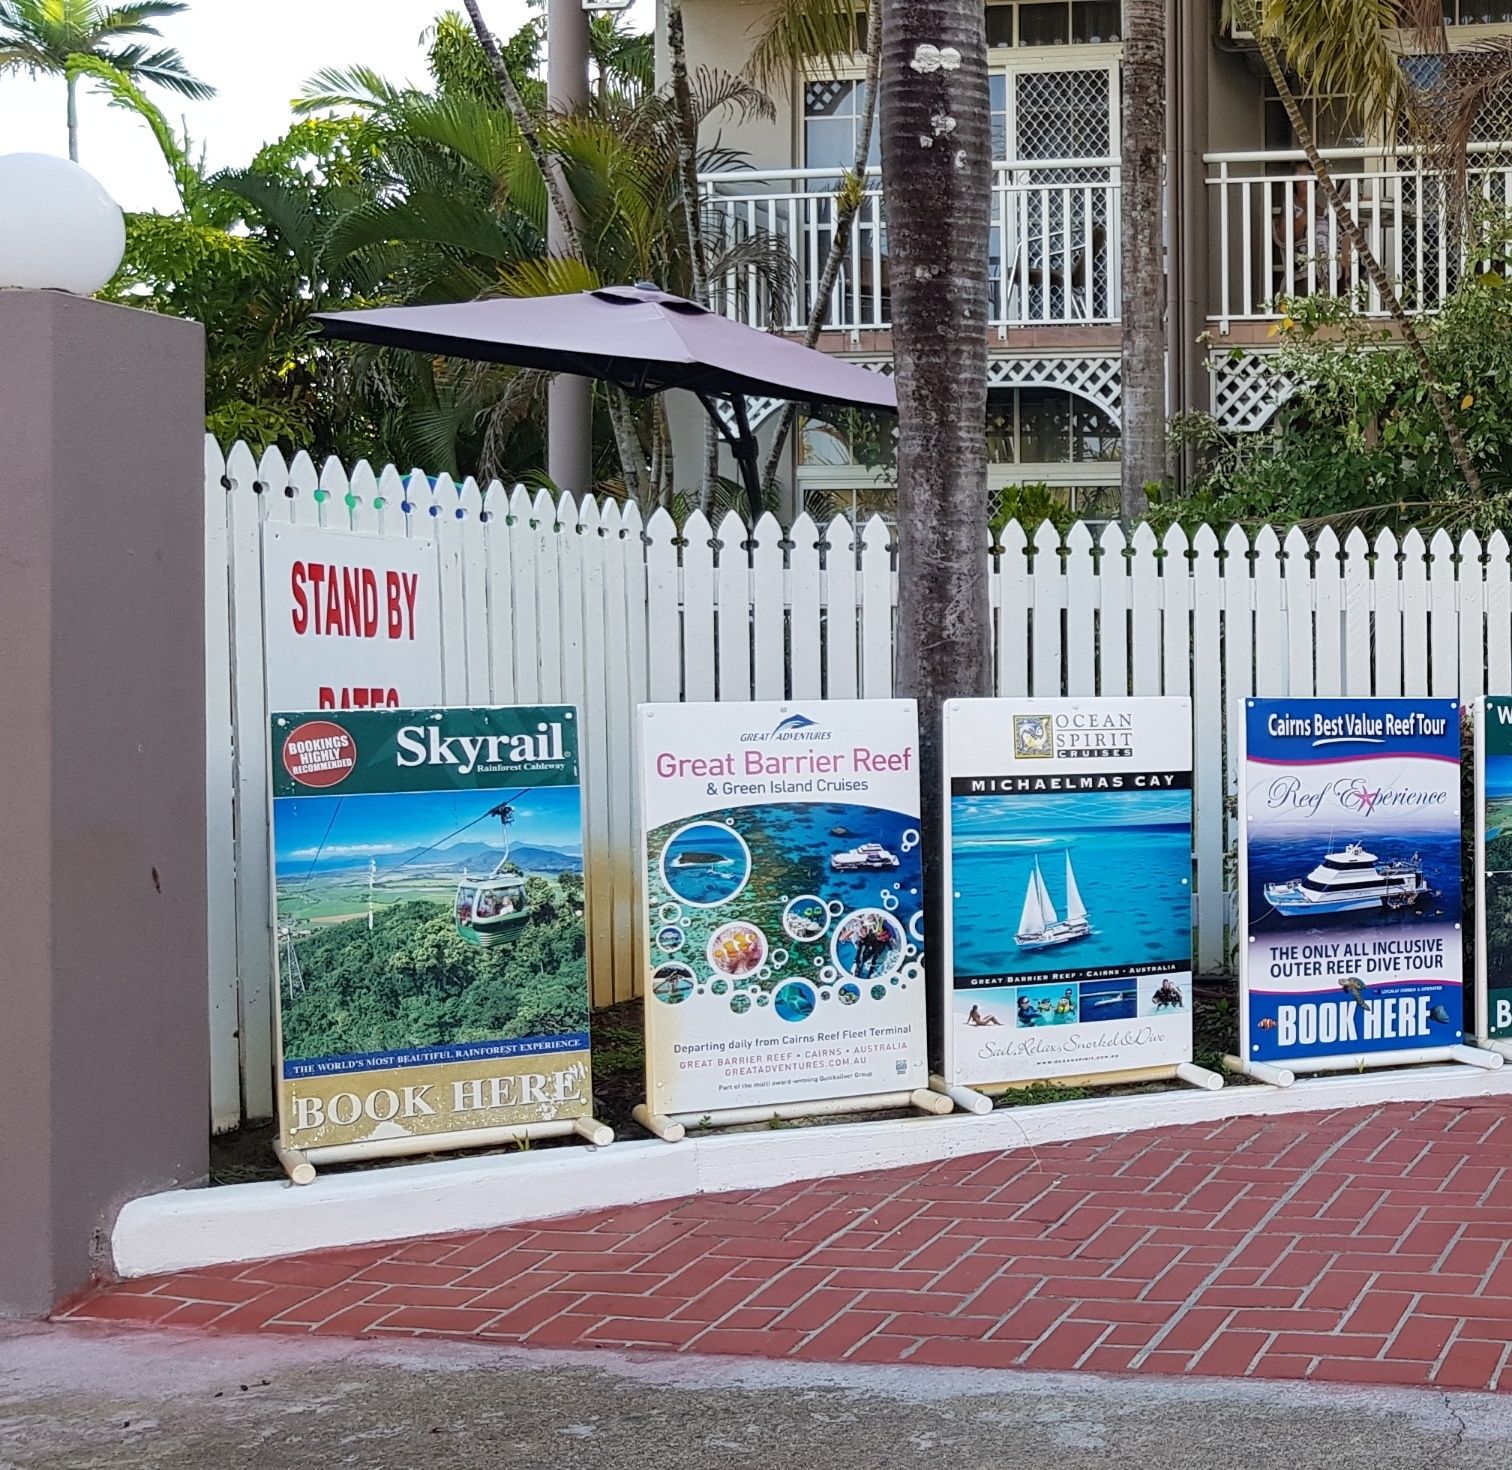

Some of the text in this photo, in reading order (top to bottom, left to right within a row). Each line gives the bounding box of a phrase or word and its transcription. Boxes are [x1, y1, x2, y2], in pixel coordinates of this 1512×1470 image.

[291, 560, 418, 640] STAND BY
[1056, 713, 1132, 728] OCEAN
[1268, 712, 1446, 737] Cairns Best Value Reef Tour
[288, 736, 349, 755] BOOKINGS
[740, 731, 832, 742] GREAT ADVENTURES
[1057, 732, 1133, 748] SPIRIT
[300, 748, 341, 765] HIGHLY
[397, 723, 565, 774] Skyrail
[1058, 749, 1132, 758] CRUISES
[292, 758, 352, 776] RECOMMENDED
[477, 763, 565, 773] Rainforest Cableway
[656, 747, 912, 778] Great Barrier Reef
[706, 778, 869, 796] & Green Island Cruises
[972, 775, 1175, 792] MICHAELMAS CAY
[1267, 775, 1447, 818] Reef Experience
[1270, 938, 1443, 961] THE ONLY ALL INCLUSIVE
[971, 963, 1177, 986] GREAT BARRIER REEF CAIRNS AUSTRALIA
[1270, 954, 1443, 978] OUTER REEF DIVE TOUR
[1278, 996, 1431, 1046] BOOK HERE
[674, 1024, 912, 1054] Departing daily from Cairns Reef Fleet Terminal
[978, 1027, 1165, 1059] Sail, Relax, Snorkel & Dive
[293, 1039, 581, 1074] THE WORLD'S MOST BEAUTIFUL RAINFOREST EXPERIENCE
[679, 1041, 908, 1069] GREAT BARRIER REEF CAIRNS AUSTRALIA
[725, 1056, 867, 1077] GREATADVENTURES.COM.AU
[855, 1071, 873, 1079] Group
[295, 1070, 582, 1130] BOOK HERE
